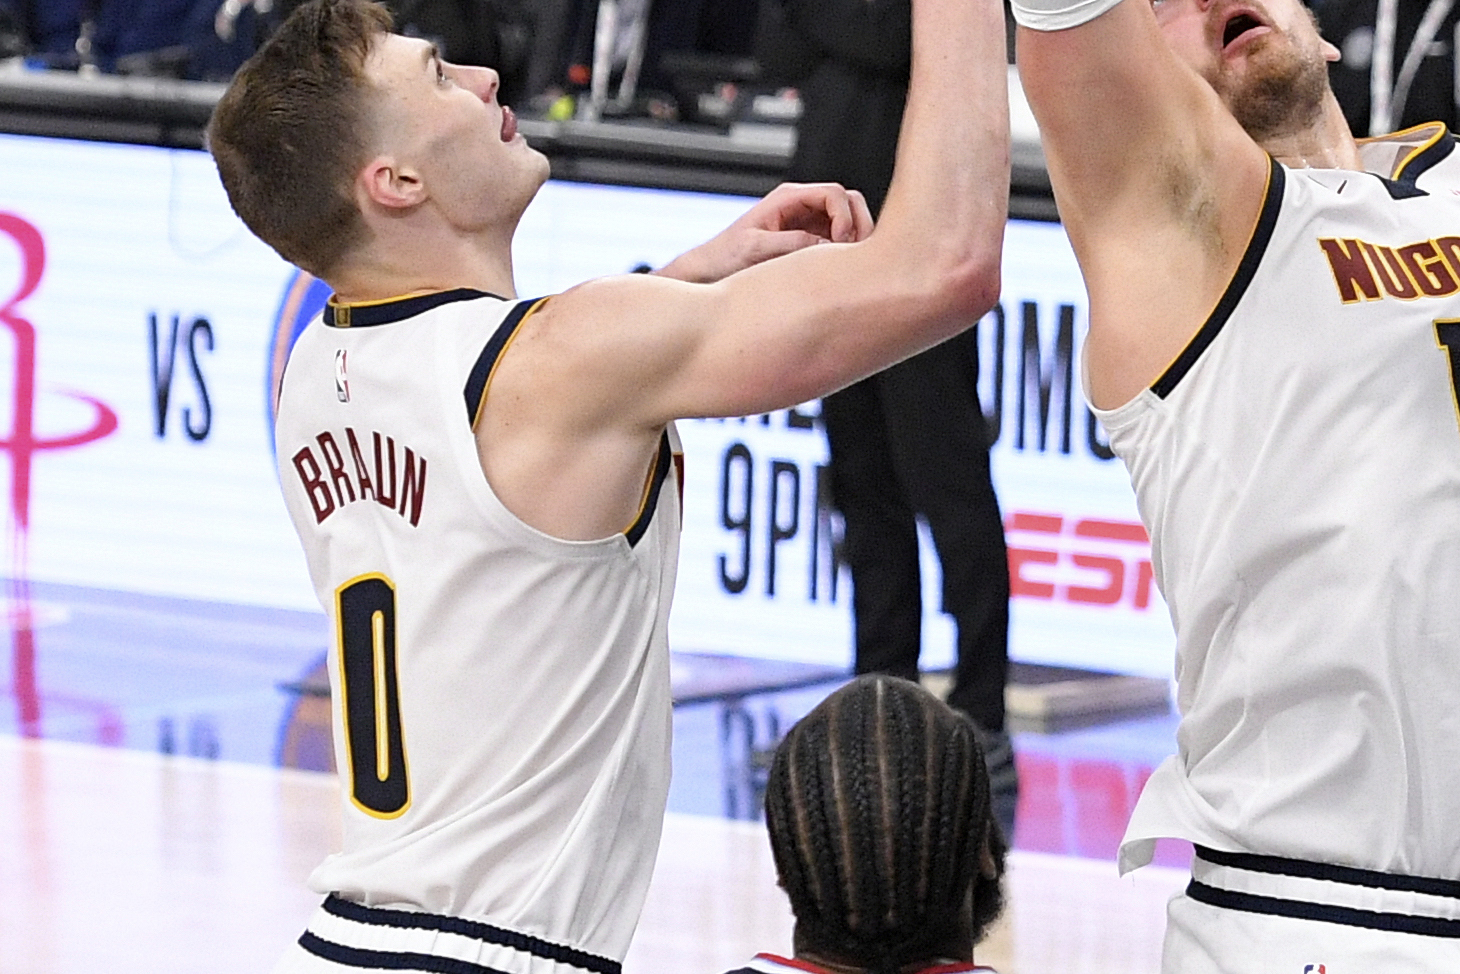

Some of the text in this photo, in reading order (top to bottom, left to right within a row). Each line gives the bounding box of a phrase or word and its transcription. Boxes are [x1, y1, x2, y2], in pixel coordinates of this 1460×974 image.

[149, 313, 214, 442] VS
[291, 427, 428, 529] BRAUN
[334, 571, 413, 821] 0
